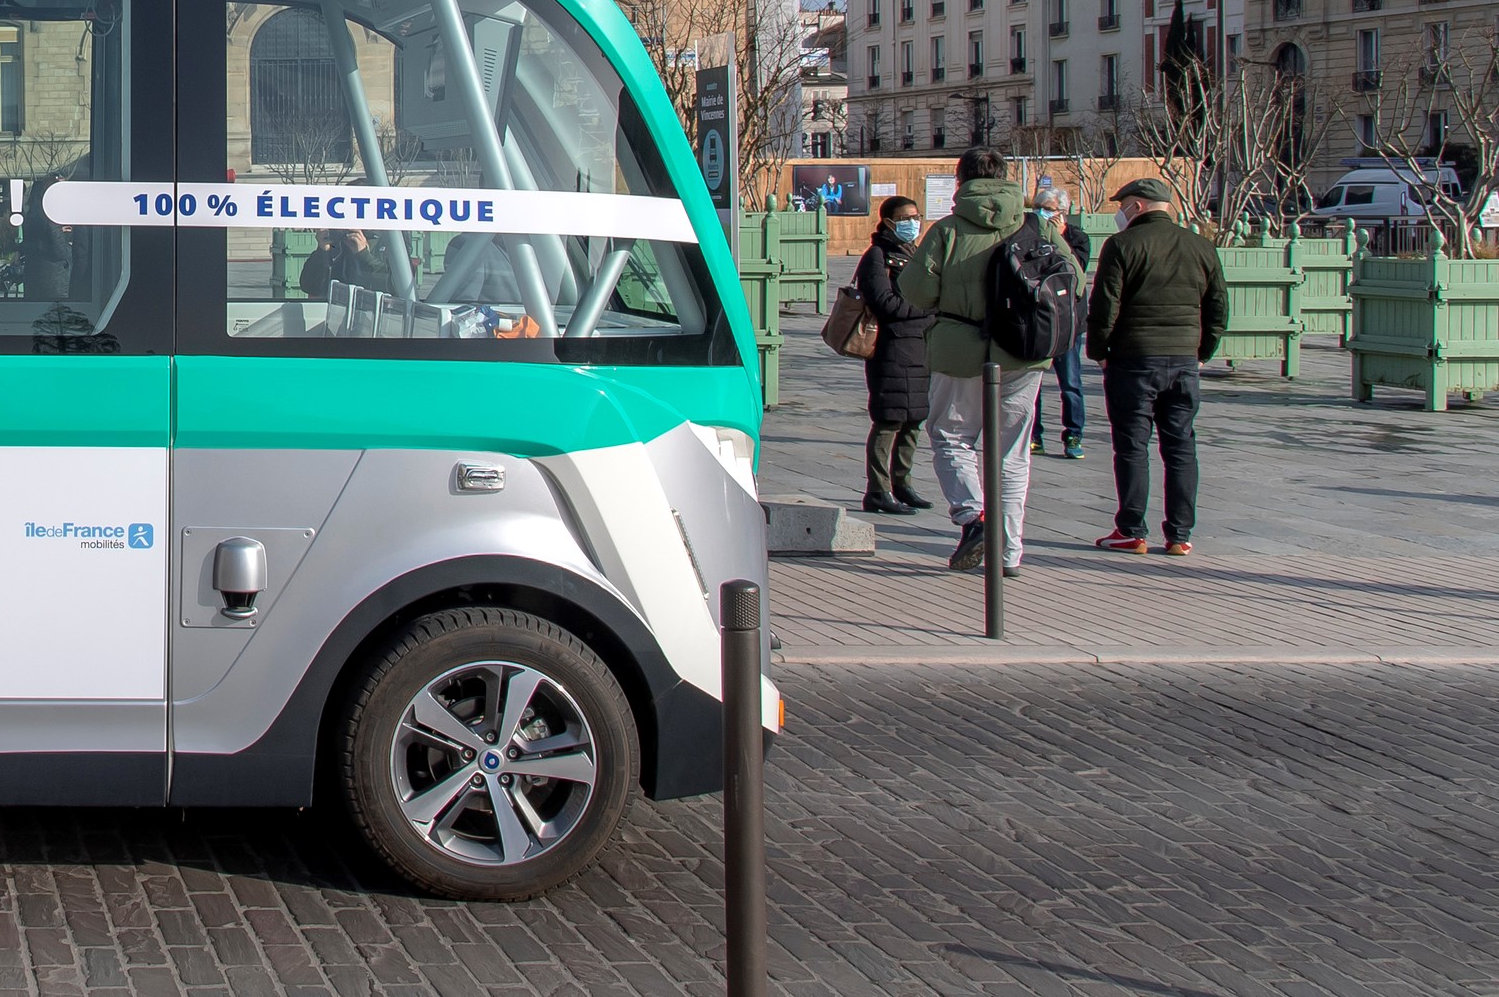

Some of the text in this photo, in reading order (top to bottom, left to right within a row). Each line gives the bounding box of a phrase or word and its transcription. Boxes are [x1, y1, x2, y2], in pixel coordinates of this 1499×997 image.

[132, 190, 495, 225] 100 % ÉLECTRIQUE
[80, 538, 125, 550] mobilités
